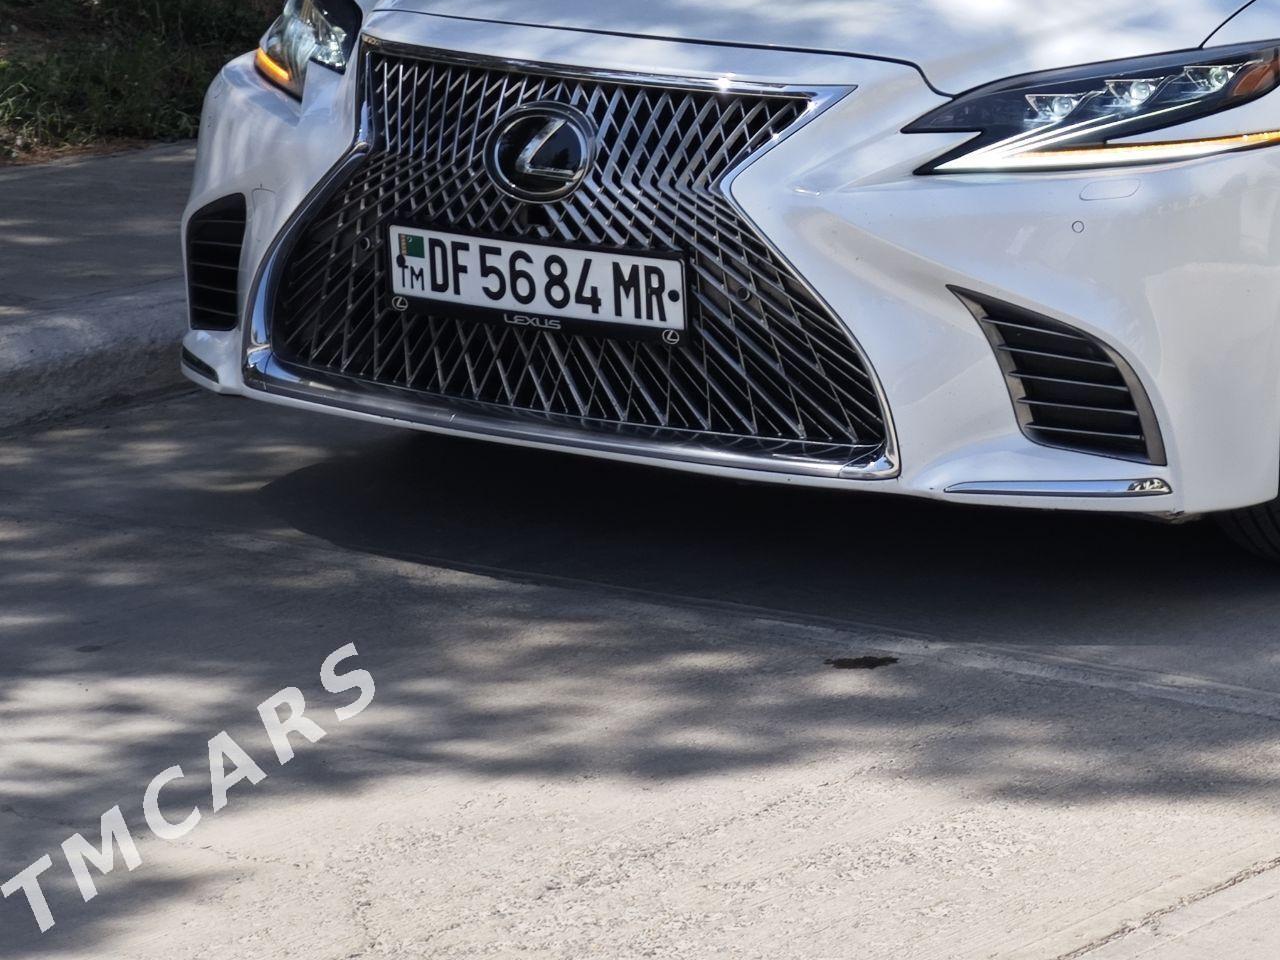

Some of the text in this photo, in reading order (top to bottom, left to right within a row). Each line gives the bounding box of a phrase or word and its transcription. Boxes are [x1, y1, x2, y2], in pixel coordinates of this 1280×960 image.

[400, 237, 668, 322] TM DF 5684 MR
[503, 313, 562, 330] LEXUS
